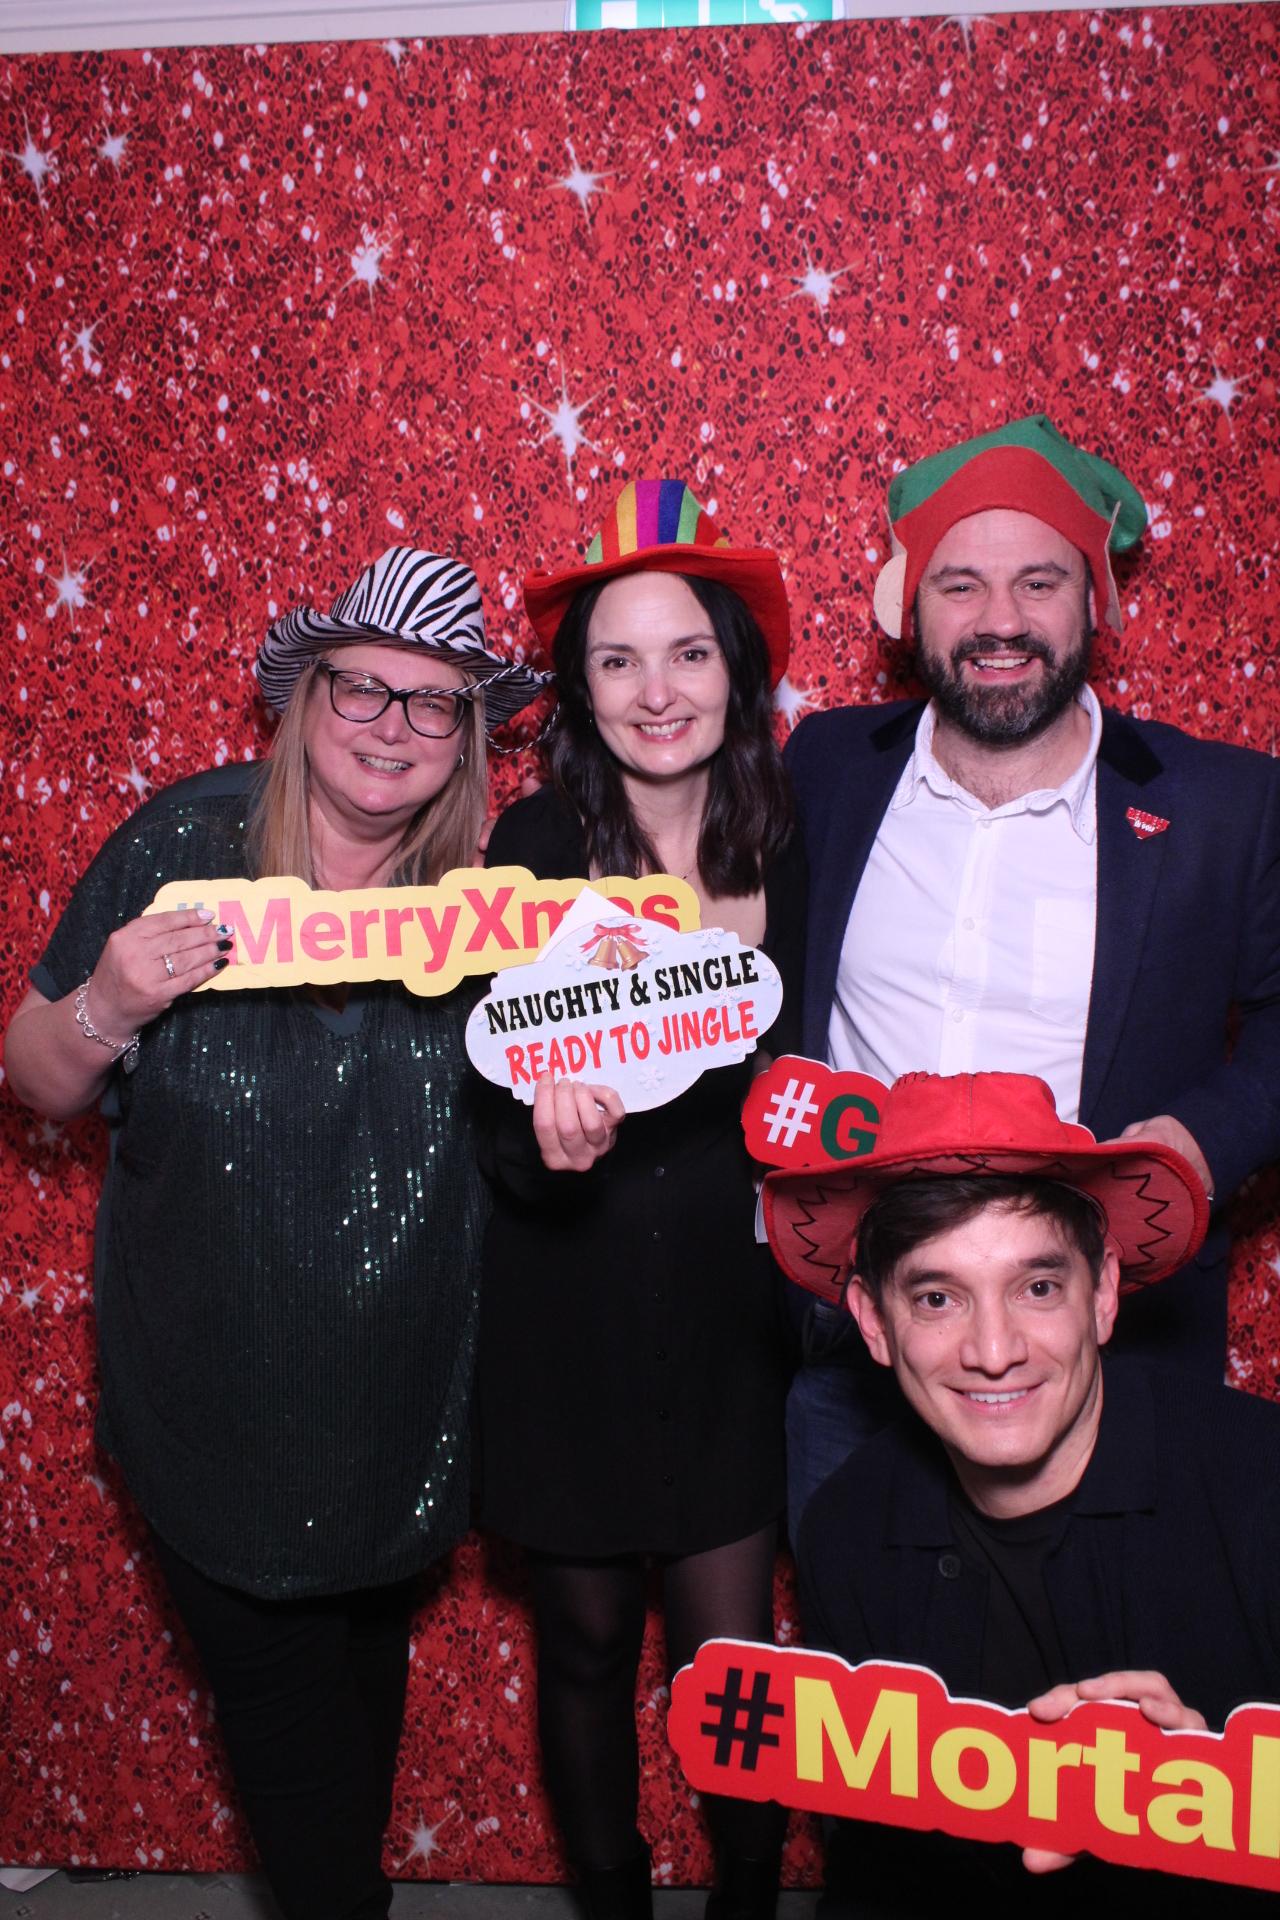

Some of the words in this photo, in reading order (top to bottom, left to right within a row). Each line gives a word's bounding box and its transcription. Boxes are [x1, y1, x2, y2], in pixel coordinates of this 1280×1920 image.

[177, 886, 682, 973] MerryXms
[484, 978, 620, 1035] NAUGHTY
[629, 973, 652, 1007] &
[654, 950, 760, 1001] SINGLE
[505, 1029, 603, 1086] READY
[609, 1021, 650, 1064] TO
[657, 1000, 759, 1056] JINGLE
